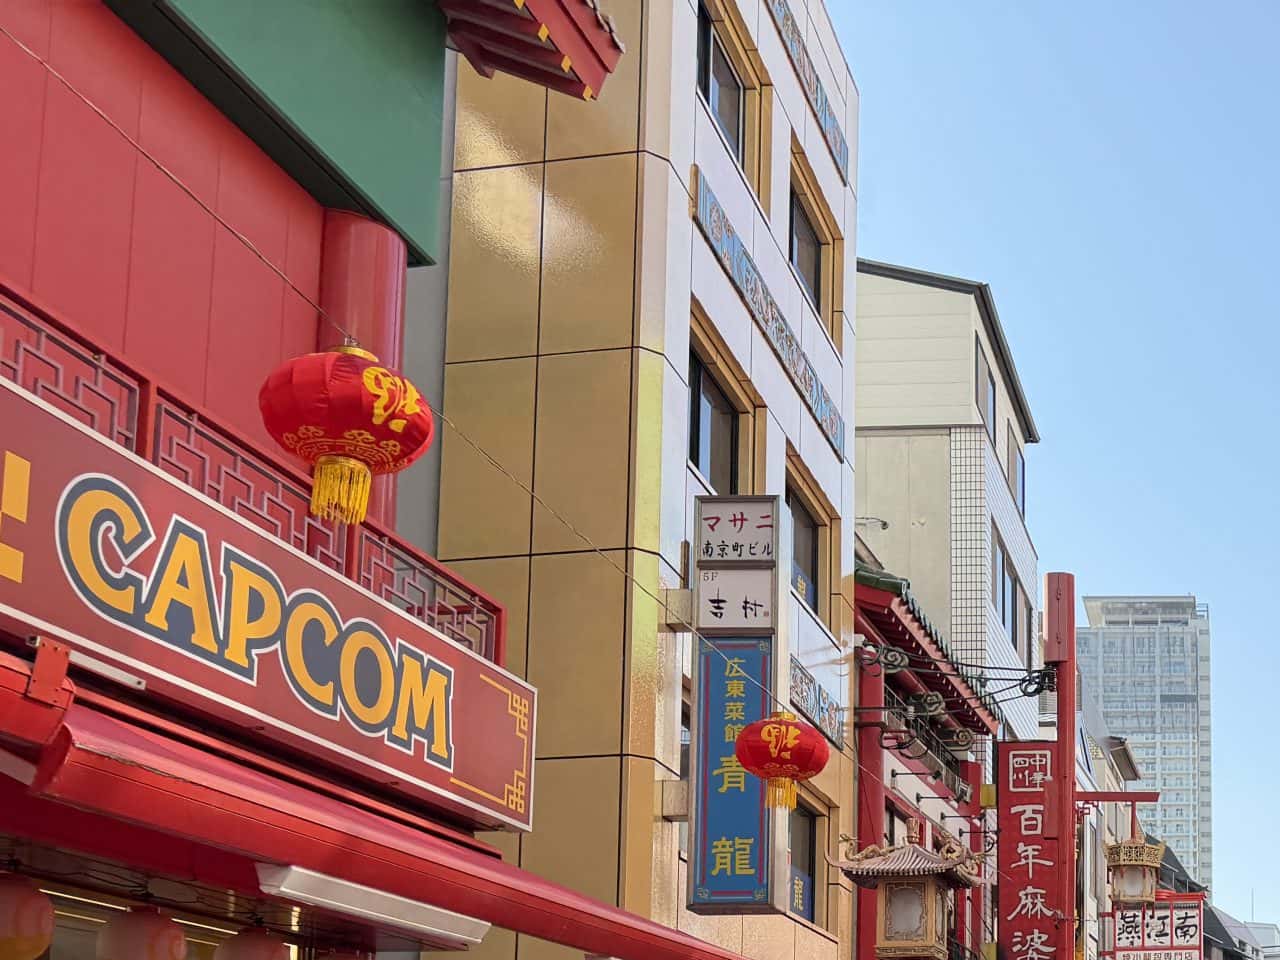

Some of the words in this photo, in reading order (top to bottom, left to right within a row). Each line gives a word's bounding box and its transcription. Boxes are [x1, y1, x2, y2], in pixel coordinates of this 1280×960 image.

[702, 513, 773, 533] マサニ
[702, 541, 773, 559] 南京町ビル
[708, 588, 763, 619] 吉村
[55, 472, 455, 772] CAPCOM
[711, 755, 756, 877] 青龍
